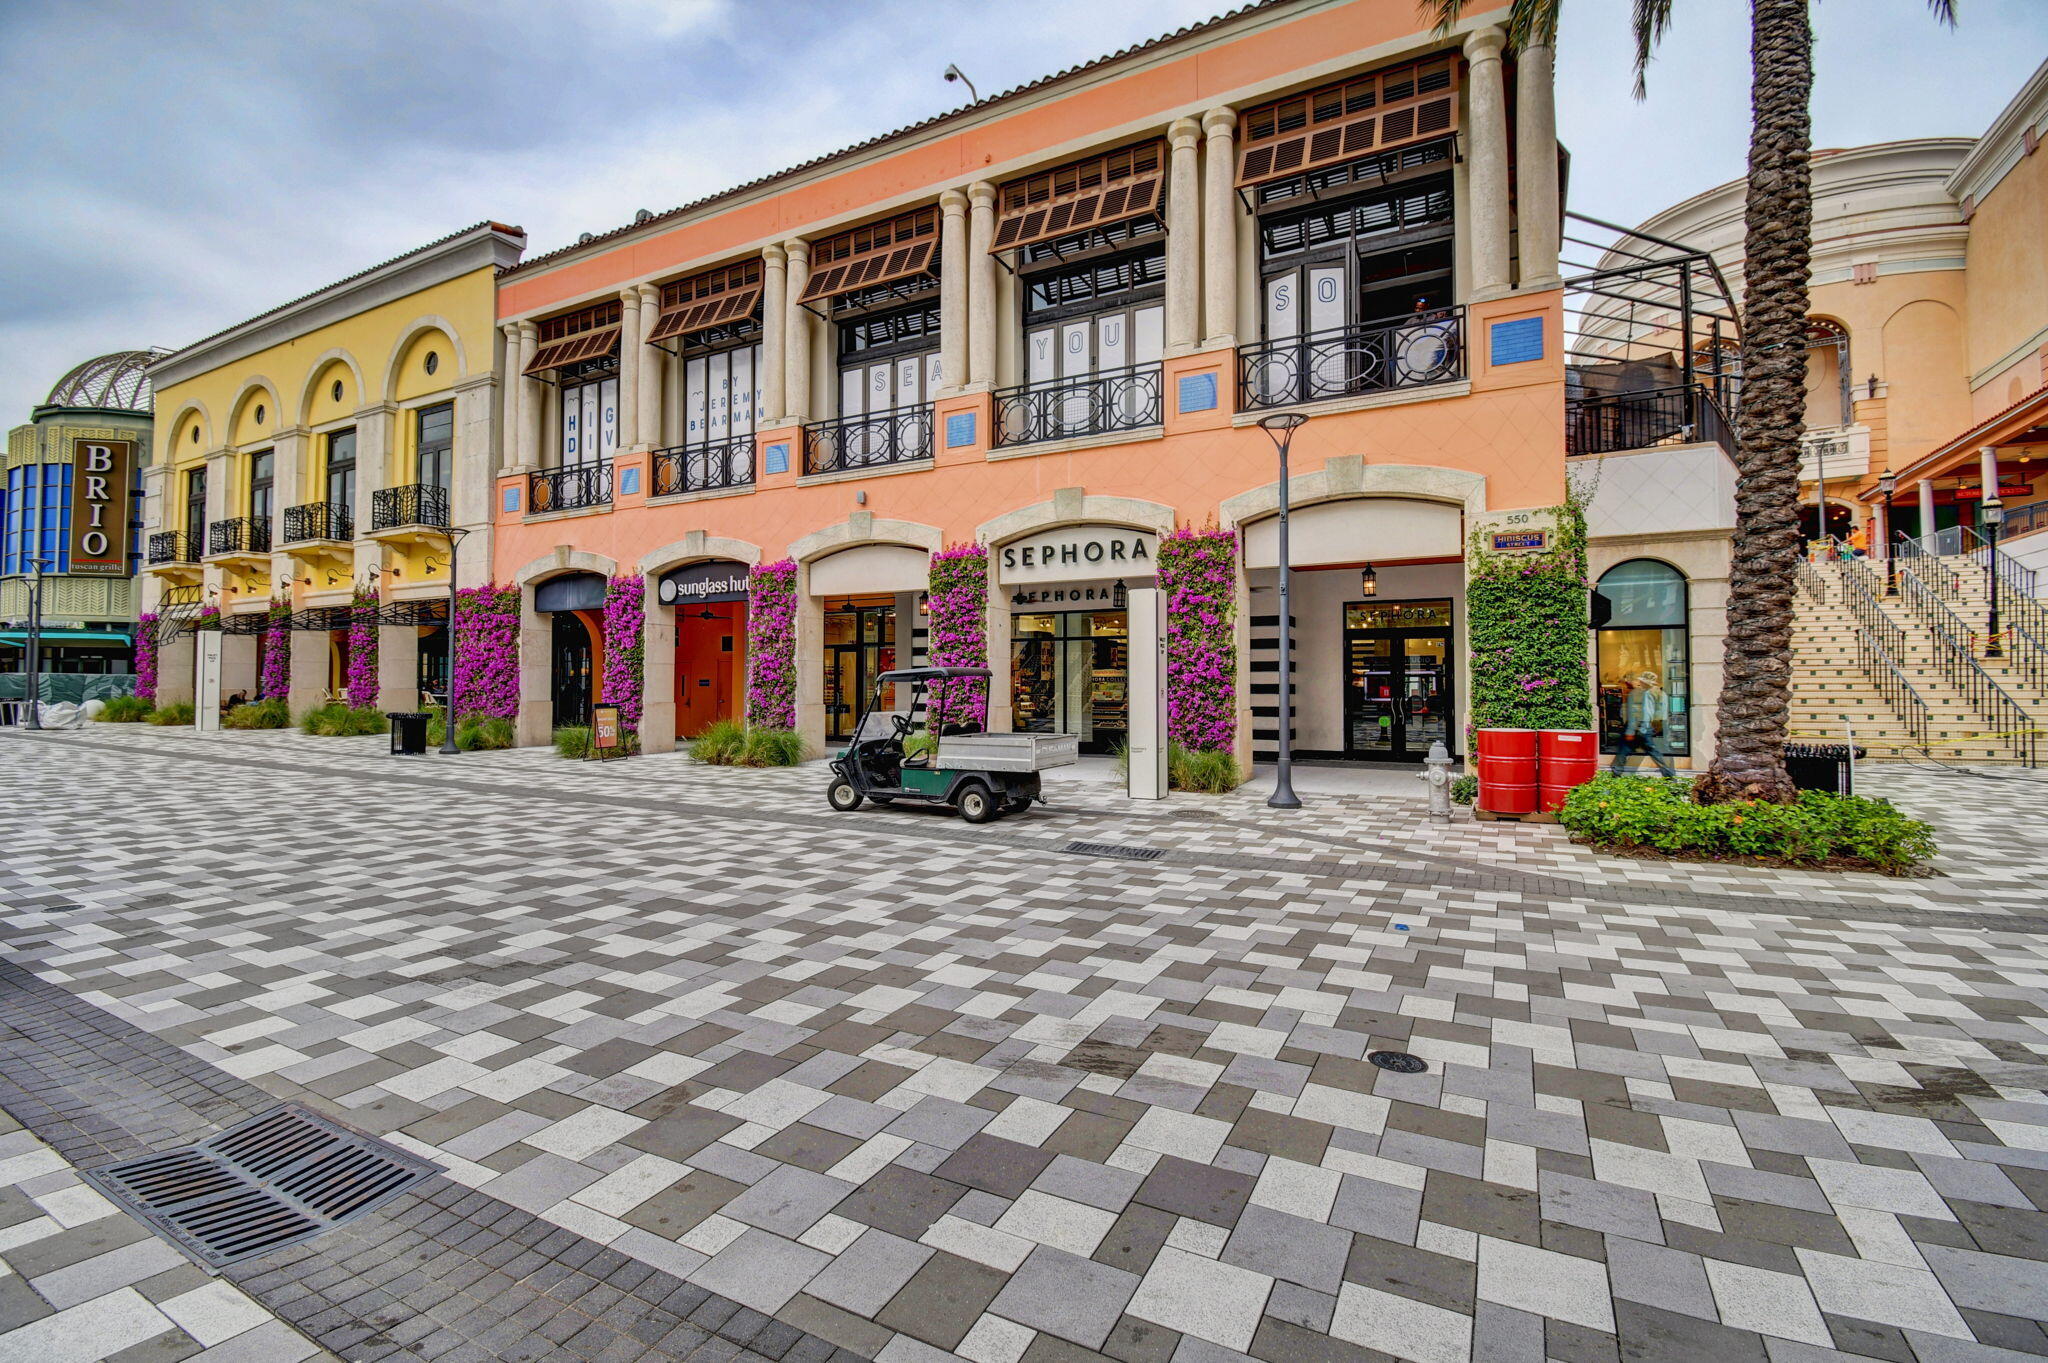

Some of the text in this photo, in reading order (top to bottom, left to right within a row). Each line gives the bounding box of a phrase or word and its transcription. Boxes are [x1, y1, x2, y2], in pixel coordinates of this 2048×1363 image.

[1036, 322, 1120, 360] YOU
[722, 375, 739, 390] BY
[875, 359, 943, 392] SEA
[699, 388, 762, 412] JEREMY
[690, 407, 765, 431] BEARMAN
[82, 444, 112, 556] BRIO
[1507, 514, 1529, 525] 550
[1497, 534, 1540, 543] HIBISCUS
[1004, 538, 1149, 568] SEPHORA
[71, 562, 123, 572] tuscan grille
[677, 575, 750, 599] sunglass hut
[1028, 588, 1110, 603] EPHORA
[1360, 609, 1438, 622] SEPHORA
